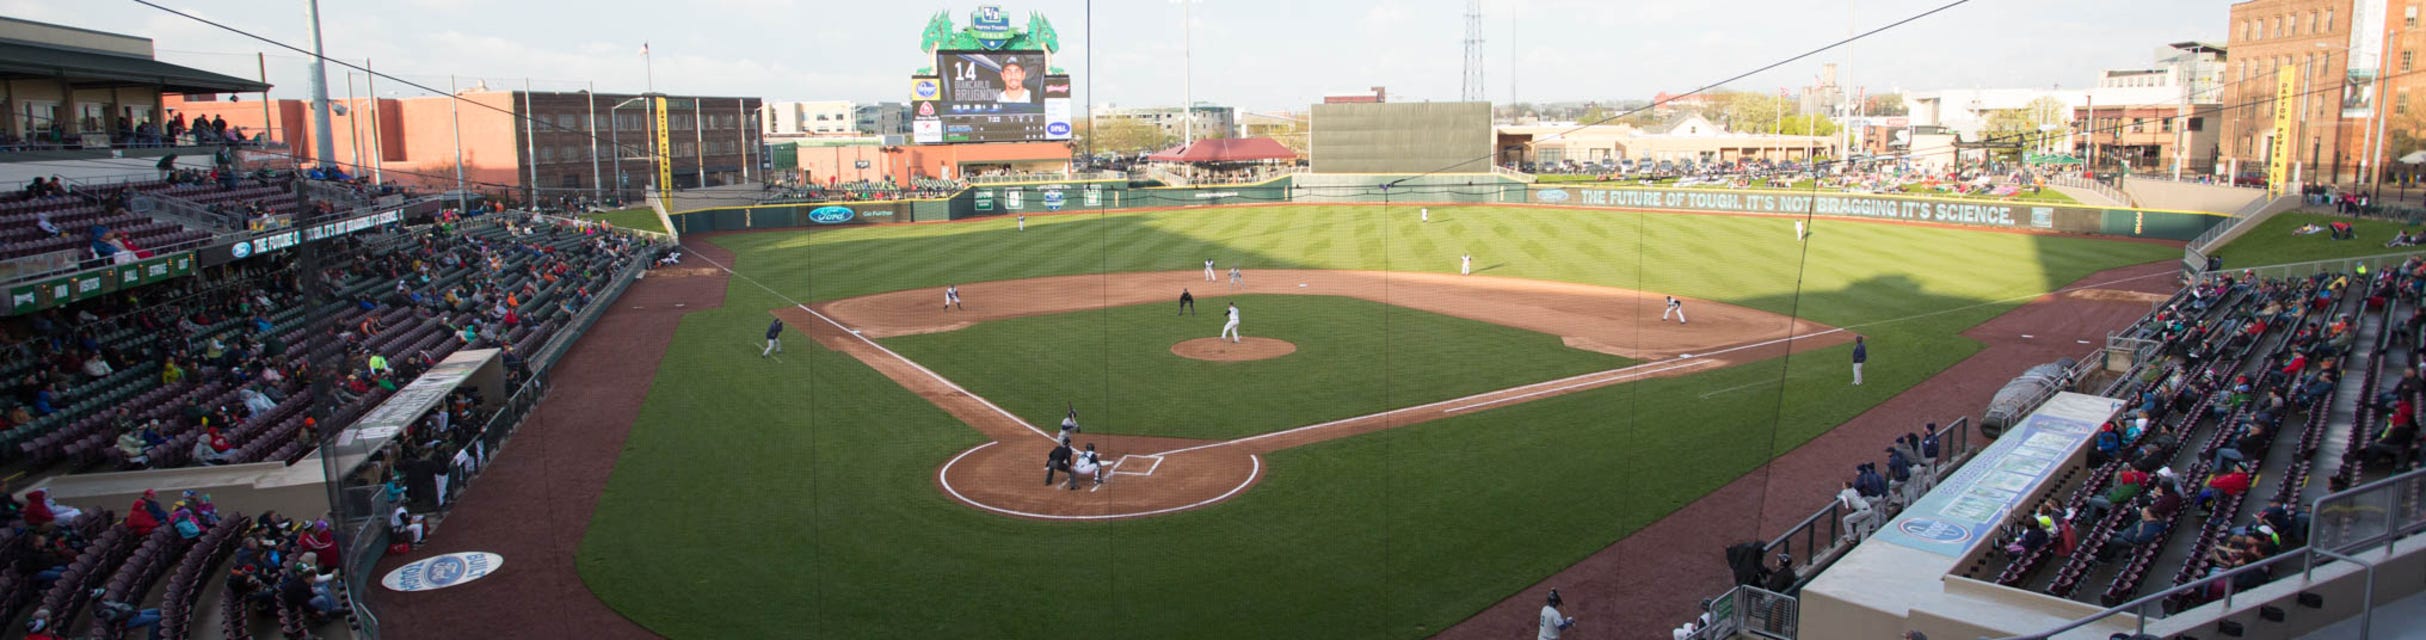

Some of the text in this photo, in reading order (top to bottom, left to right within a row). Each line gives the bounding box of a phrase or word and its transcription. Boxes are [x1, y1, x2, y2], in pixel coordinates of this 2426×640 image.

[955, 61, 976, 80] 14
[2279, 82, 2288, 120] DAYTON
[2275, 127, 2283, 158] POWER
[1580, 189, 1606, 205] THE
[1610, 190, 1662, 207] FUTURE
[1666, 191, 1684, 207] OF
[1688, 192, 1742, 210] TOUGH.
[1746, 194, 1774, 211] IT'S
[1780, 195, 1811, 214] NOT
[1816, 197, 1897, 217] BRAGGING
[1901, 201, 1930, 220] IT'S
[1935, 203, 2016, 226] SCIENCE.
[253, 237, 269, 254] THE
[268, 231, 293, 250] FUTURE
